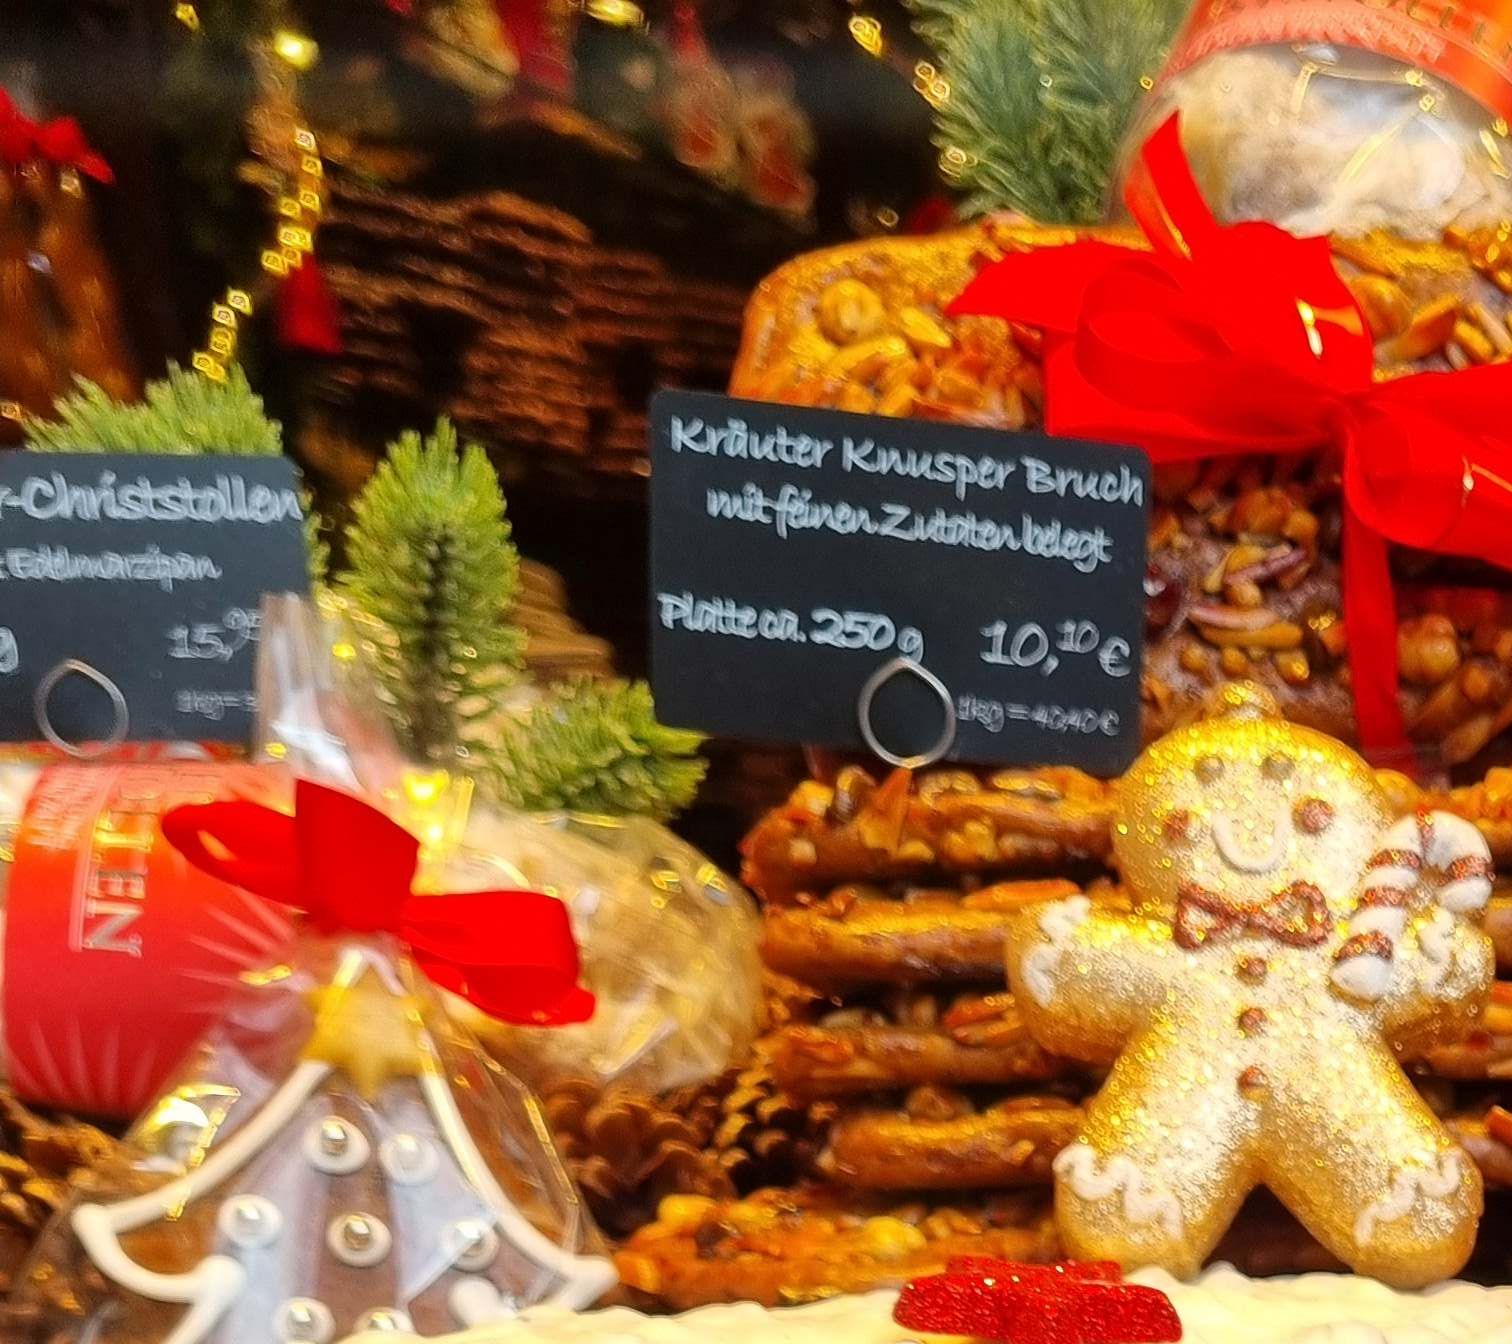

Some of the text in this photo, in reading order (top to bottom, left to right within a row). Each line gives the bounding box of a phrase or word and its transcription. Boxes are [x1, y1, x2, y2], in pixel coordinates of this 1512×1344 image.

[671, 414, 1144, 507] Kräuter Knusper Bruch
[706, 481, 1115, 574] mit feinen Zutaten belegt
[656, 590, 925, 665] Platte ca. 250 g
[979, 618, 1132, 678] 10,10 €
